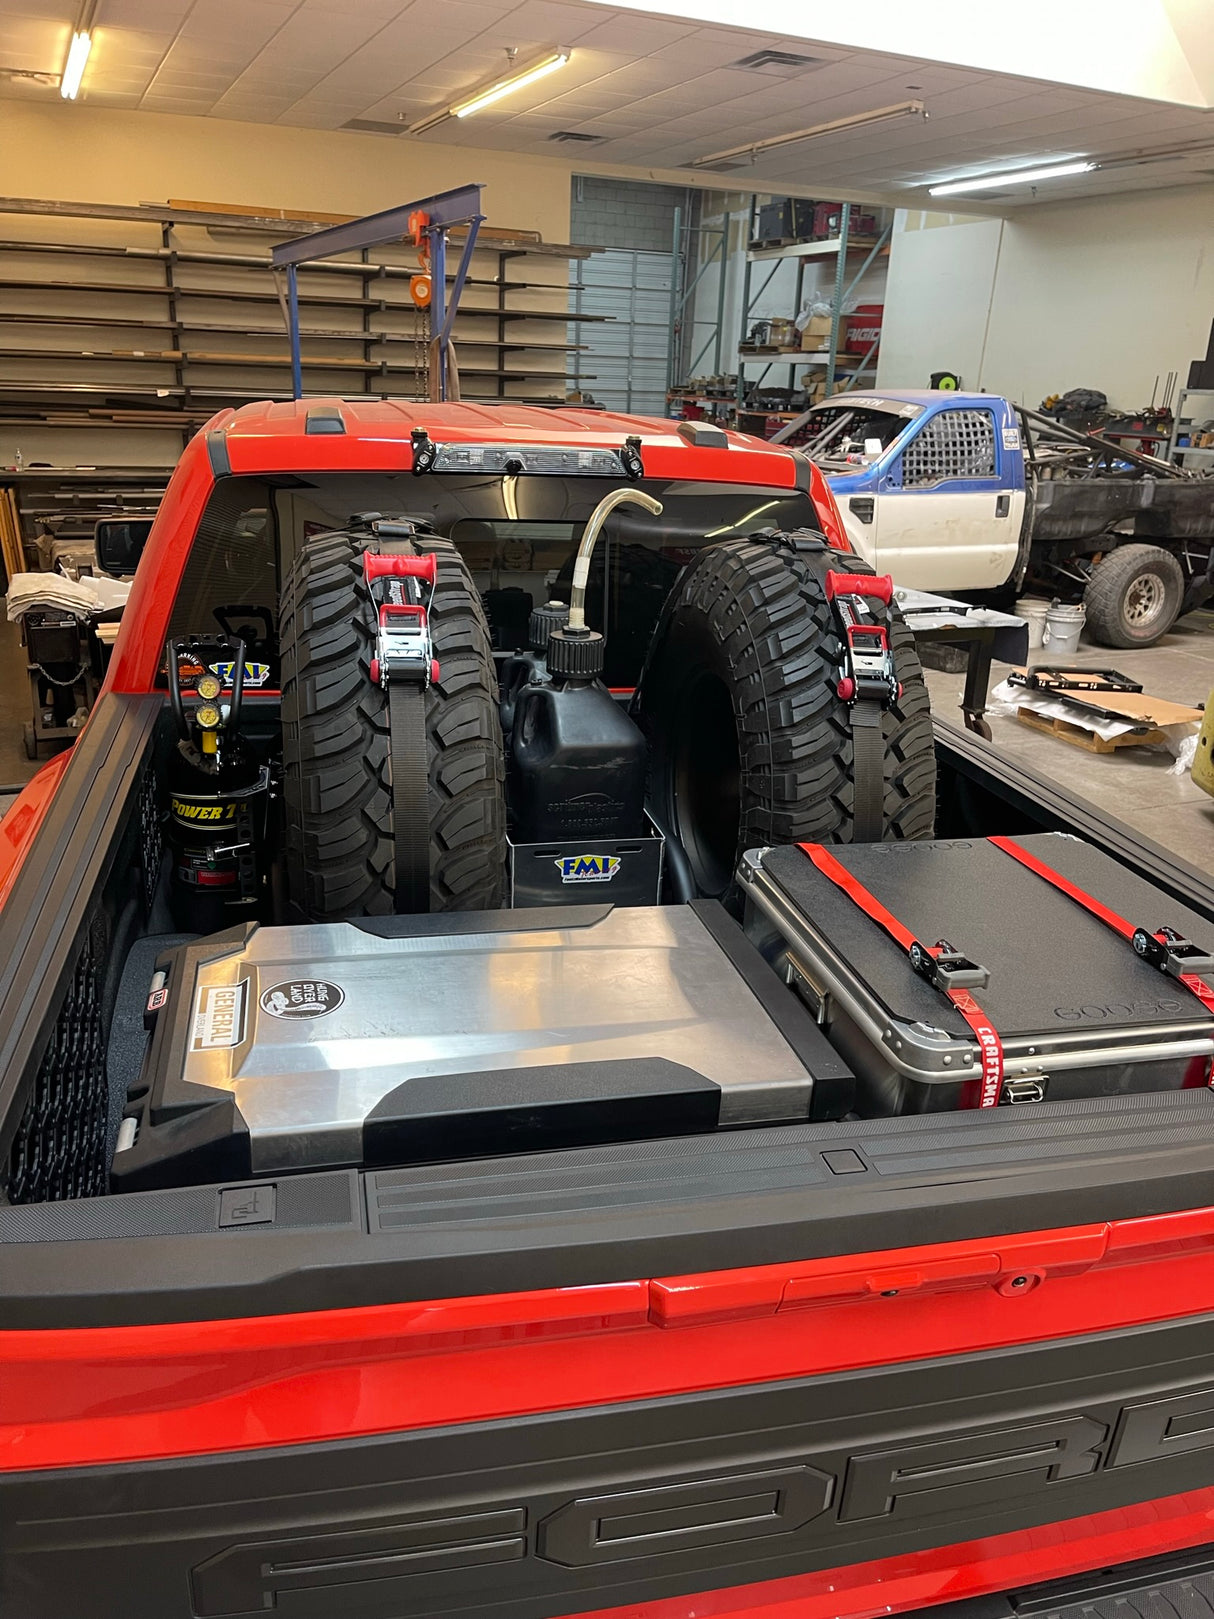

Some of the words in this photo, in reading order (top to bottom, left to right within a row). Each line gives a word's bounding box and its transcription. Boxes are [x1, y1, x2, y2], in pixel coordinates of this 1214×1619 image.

[177, 652, 199, 666] ARNING
[171, 799, 223, 819] POWER
[563, 857, 610, 876] FMI
[290, 984, 304, 1003] LAND
[302, 983, 316, 1003] OVER
[316, 983, 330, 1001] HUNG
[210, 991, 236, 1042] GENERAL
[978, 1027, 1000, 1108] CRAFTSMA
